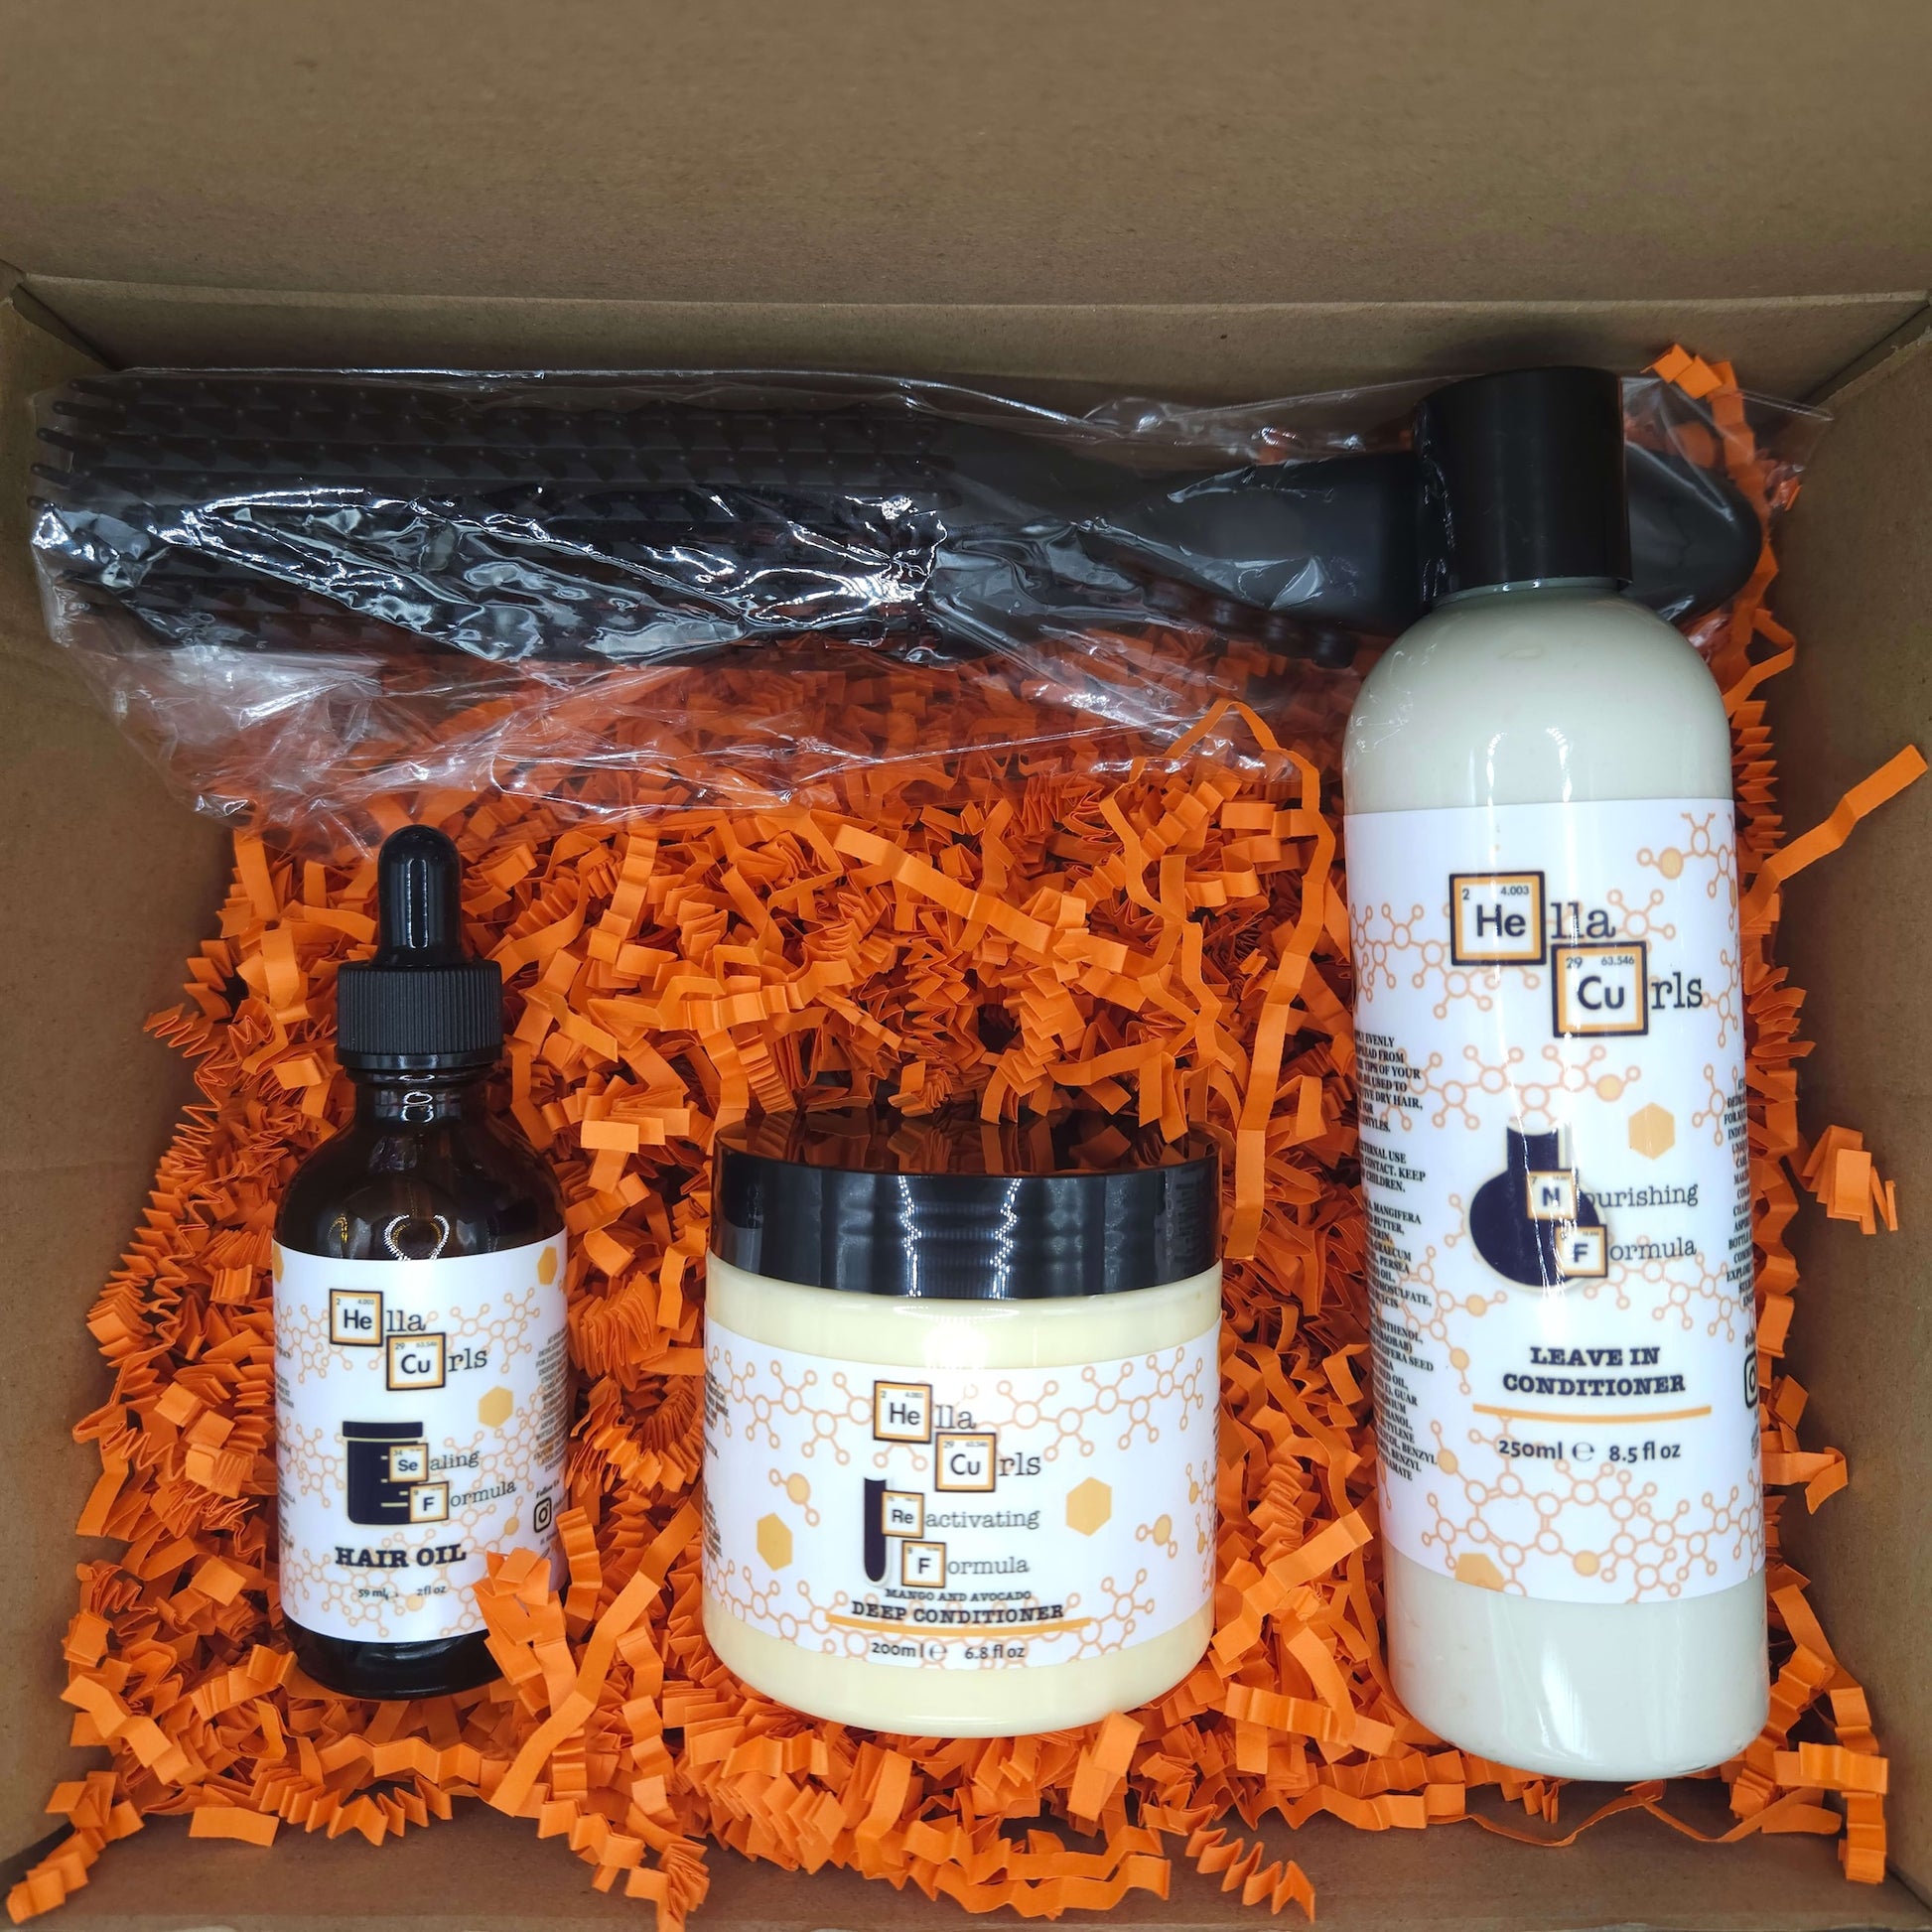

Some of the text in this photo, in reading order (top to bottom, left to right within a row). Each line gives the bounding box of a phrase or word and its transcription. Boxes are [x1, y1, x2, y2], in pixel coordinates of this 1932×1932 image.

[1461, 885, 1530, 900] 2 4.003
[1566, 955, 1635, 969] 29 63.546
[1365, 1033, 1395, 1047] EVENLY
[1378, 1049, 1404, 1063] FROM
[1379, 1063, 1391, 1076] OF
[1391, 1065, 1421, 1079] YOUR
[1371, 1076, 1393, 1090] USED
[1393, 1081, 1408, 1092] TO
[1375, 1090, 1392, 1105] DRY
[1393, 1094, 1424, 1111] HAIR,
[1388, 1150, 1407, 1165] USE
[1398, 1167, 1426, 1181] KEEP
[1373, 1201, 1422, 1225] MANGIFERA
[1573, 1237, 1698, 1263] Formula
[1379, 1255, 1410, 1275] PERSEA
[1409, 1355, 1434, 1372] SEED
[1530, 1346, 1661, 1367] LEAVE IN
[1502, 1373, 1686, 1397] CONDITIONER
[1394, 1388, 1418, 1406] GUAR
[1391, 1449, 1422, 1472] BENZYL
[1402, 1442, 1438, 1464] BENZYL
[1498, 1440, 1564, 1459] 250ml
[1608, 1446, 1638, 1463] 8.5
[422, 1480, 516, 1511] Formula
[335, 1544, 467, 1568] HAIR OIL
[917, 1556, 1031, 1575] Formula
[885, 1588, 1033, 1602] MANGO AND AVOCADO
[852, 1600, 1064, 1624] DEEP CONDITIONER
[964, 1646, 989, 1660] 6.8
